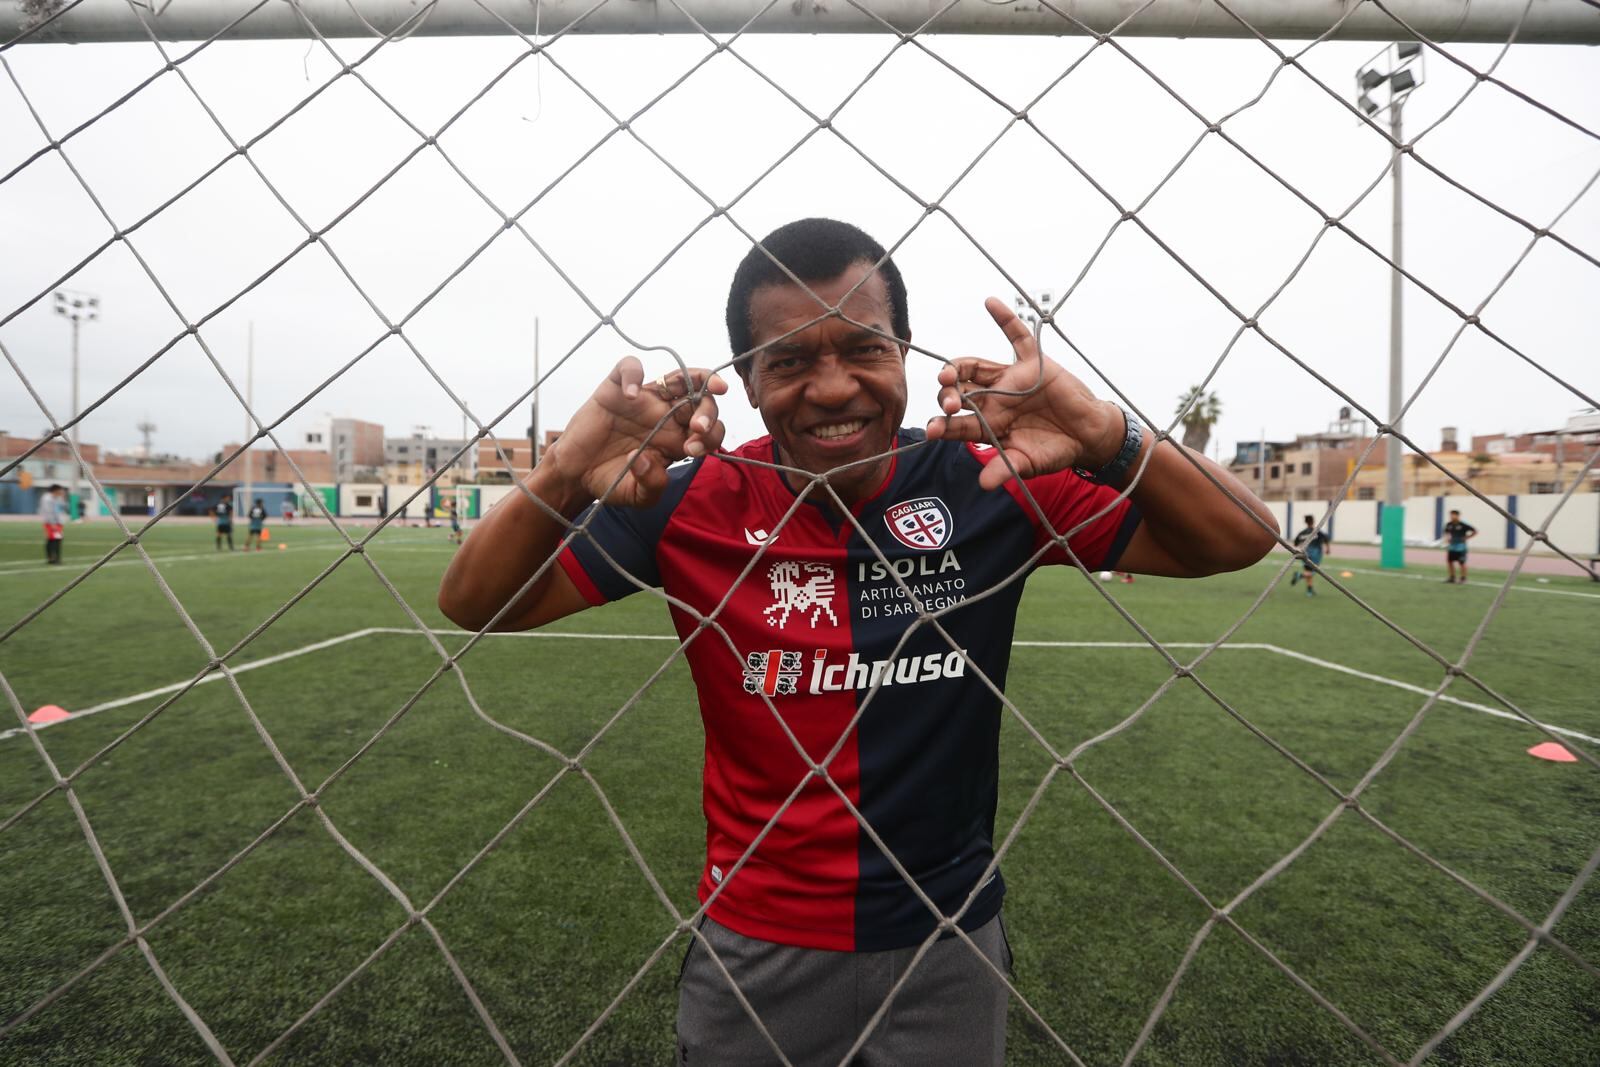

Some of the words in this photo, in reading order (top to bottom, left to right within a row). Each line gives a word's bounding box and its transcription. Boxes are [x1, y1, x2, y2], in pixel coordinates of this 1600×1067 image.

[892, 501, 936, 519] CAGLIARI
[858, 549, 961, 582] ISOLA
[860, 578, 965, 602] ARTIGANATO
[862, 606, 878, 620] DI
